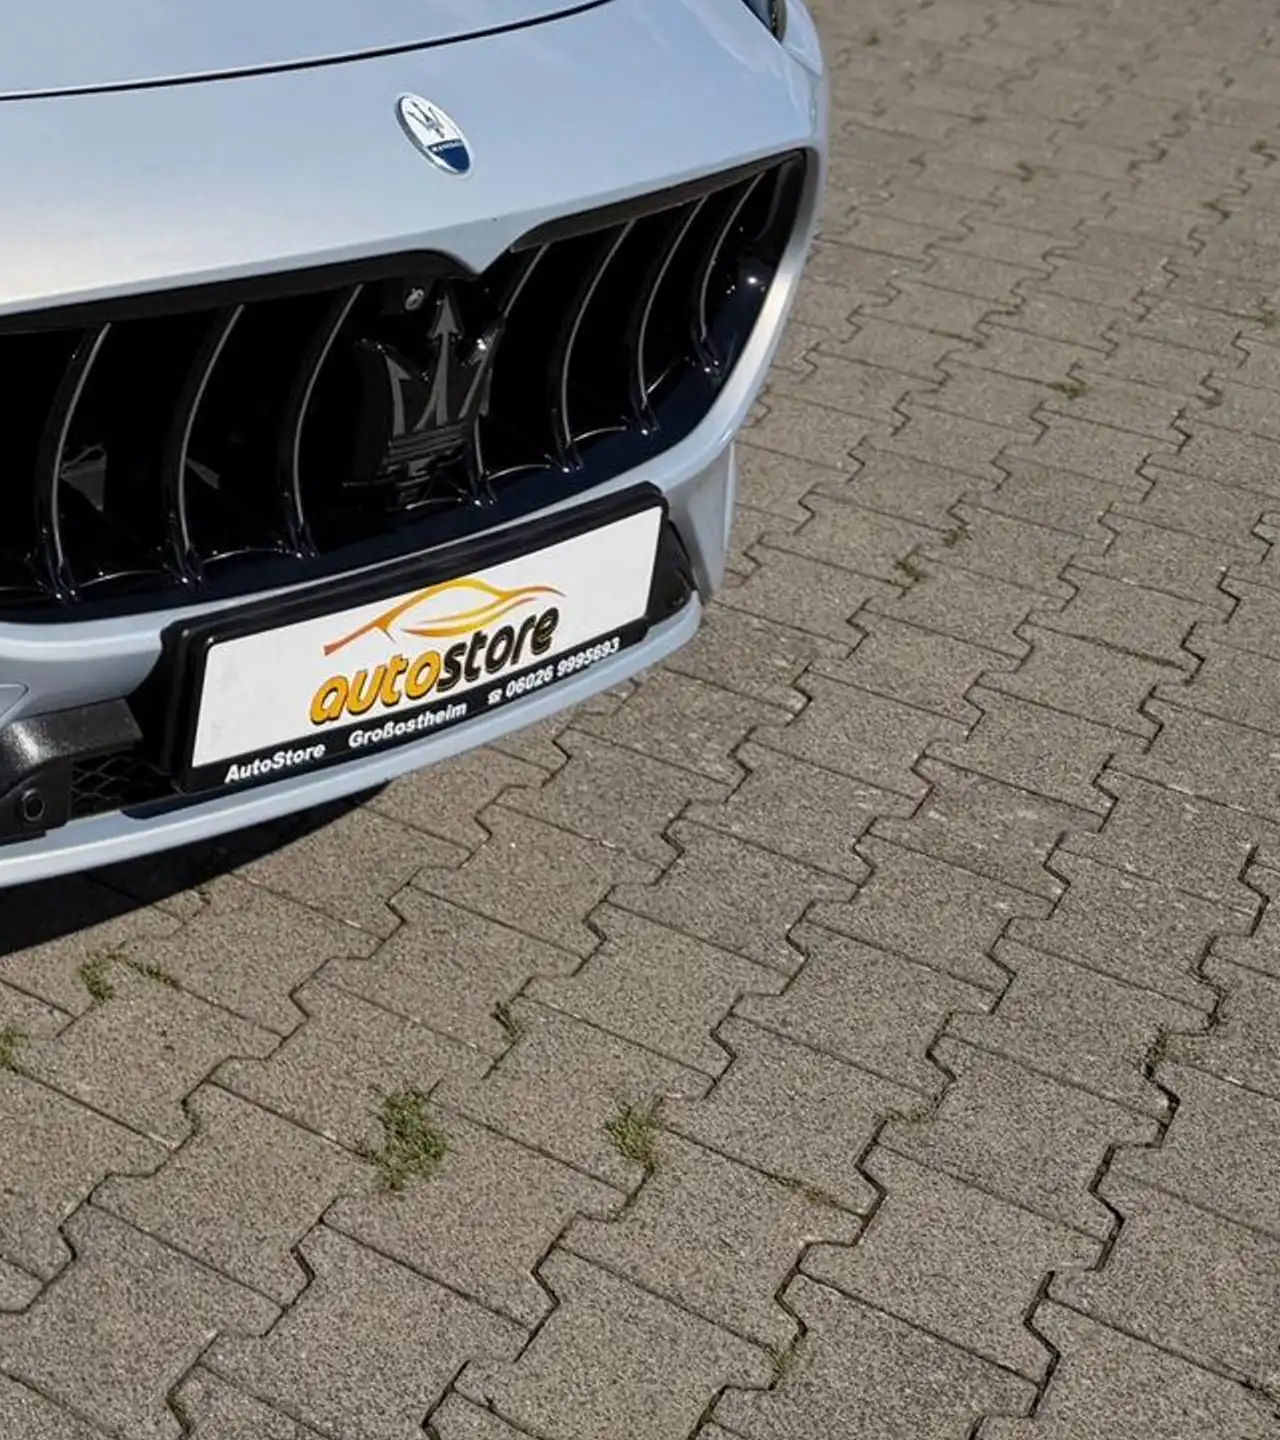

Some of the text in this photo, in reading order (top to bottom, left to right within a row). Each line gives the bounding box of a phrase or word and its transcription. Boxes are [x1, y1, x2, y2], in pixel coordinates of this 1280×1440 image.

[225, 742, 326, 783] AutoStore
[348, 702, 468, 749] Großostheim
[505, 665, 554, 698] 06026
[309, 604, 559, 725] autostore
